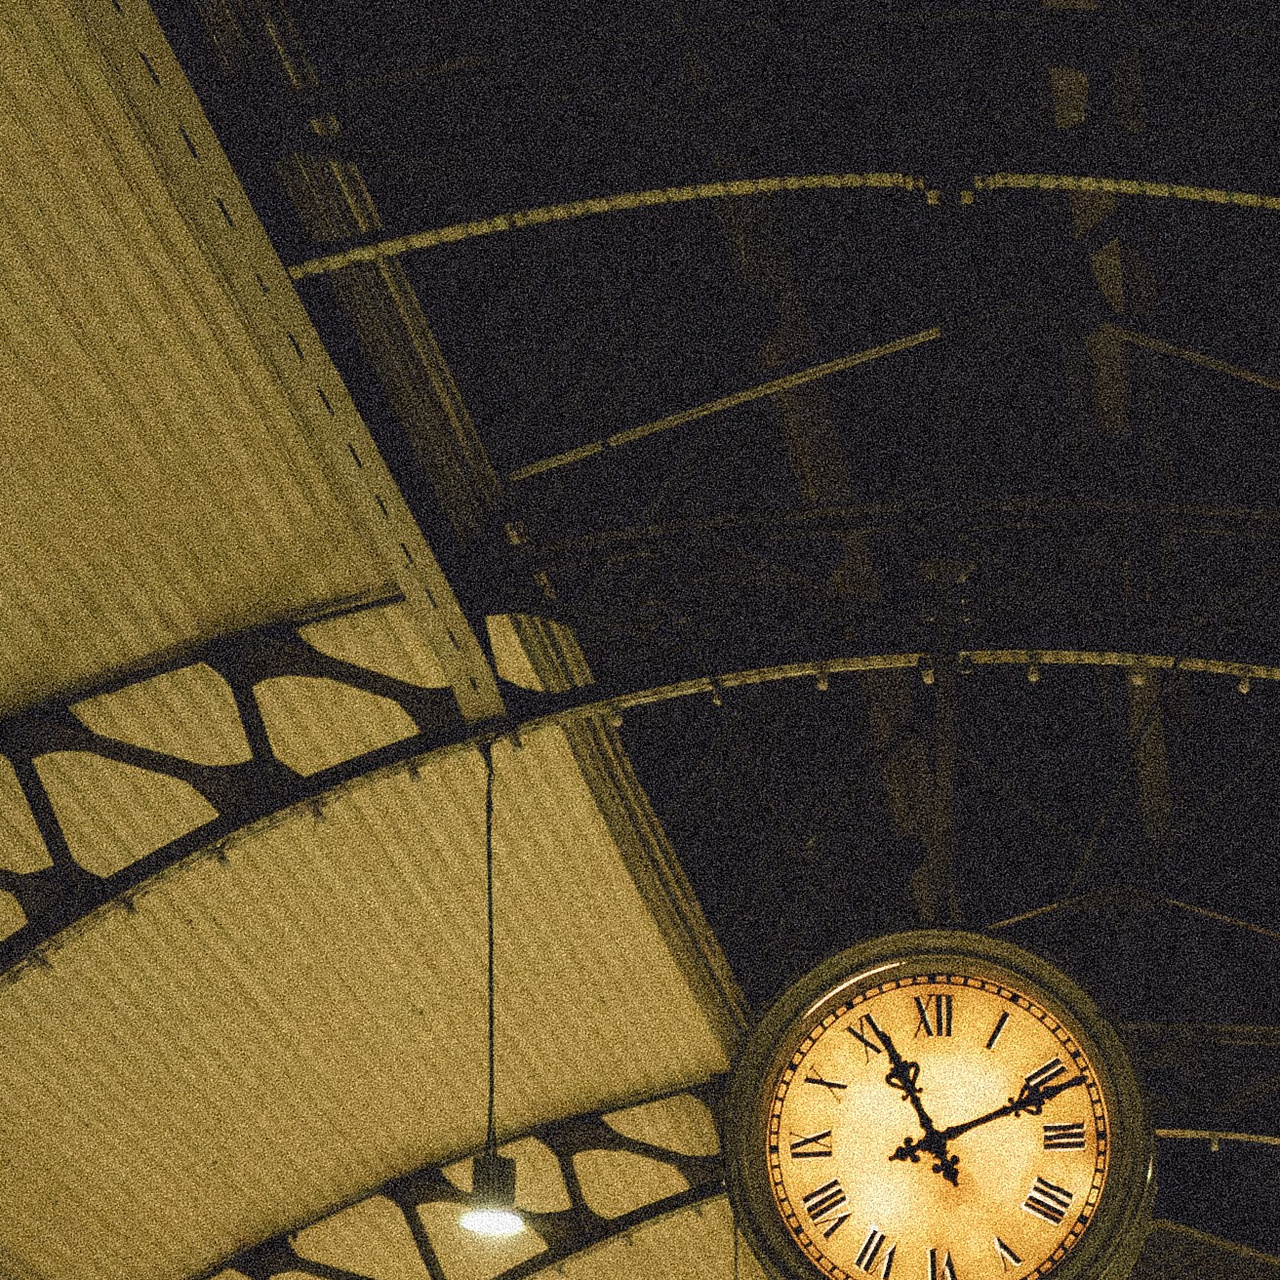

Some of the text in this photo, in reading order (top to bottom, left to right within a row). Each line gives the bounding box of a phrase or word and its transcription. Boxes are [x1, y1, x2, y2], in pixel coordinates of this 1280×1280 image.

[912, 992, 954, 1039] XII
[986, 1010, 1010, 1050] I
[804, 1064, 848, 1104] X
[789, 1129, 833, 1160] IX
[1042, 1121, 1086, 1151] III
[802, 1178, 853, 1241] VIII
[996, 1236, 1024, 1273] V
